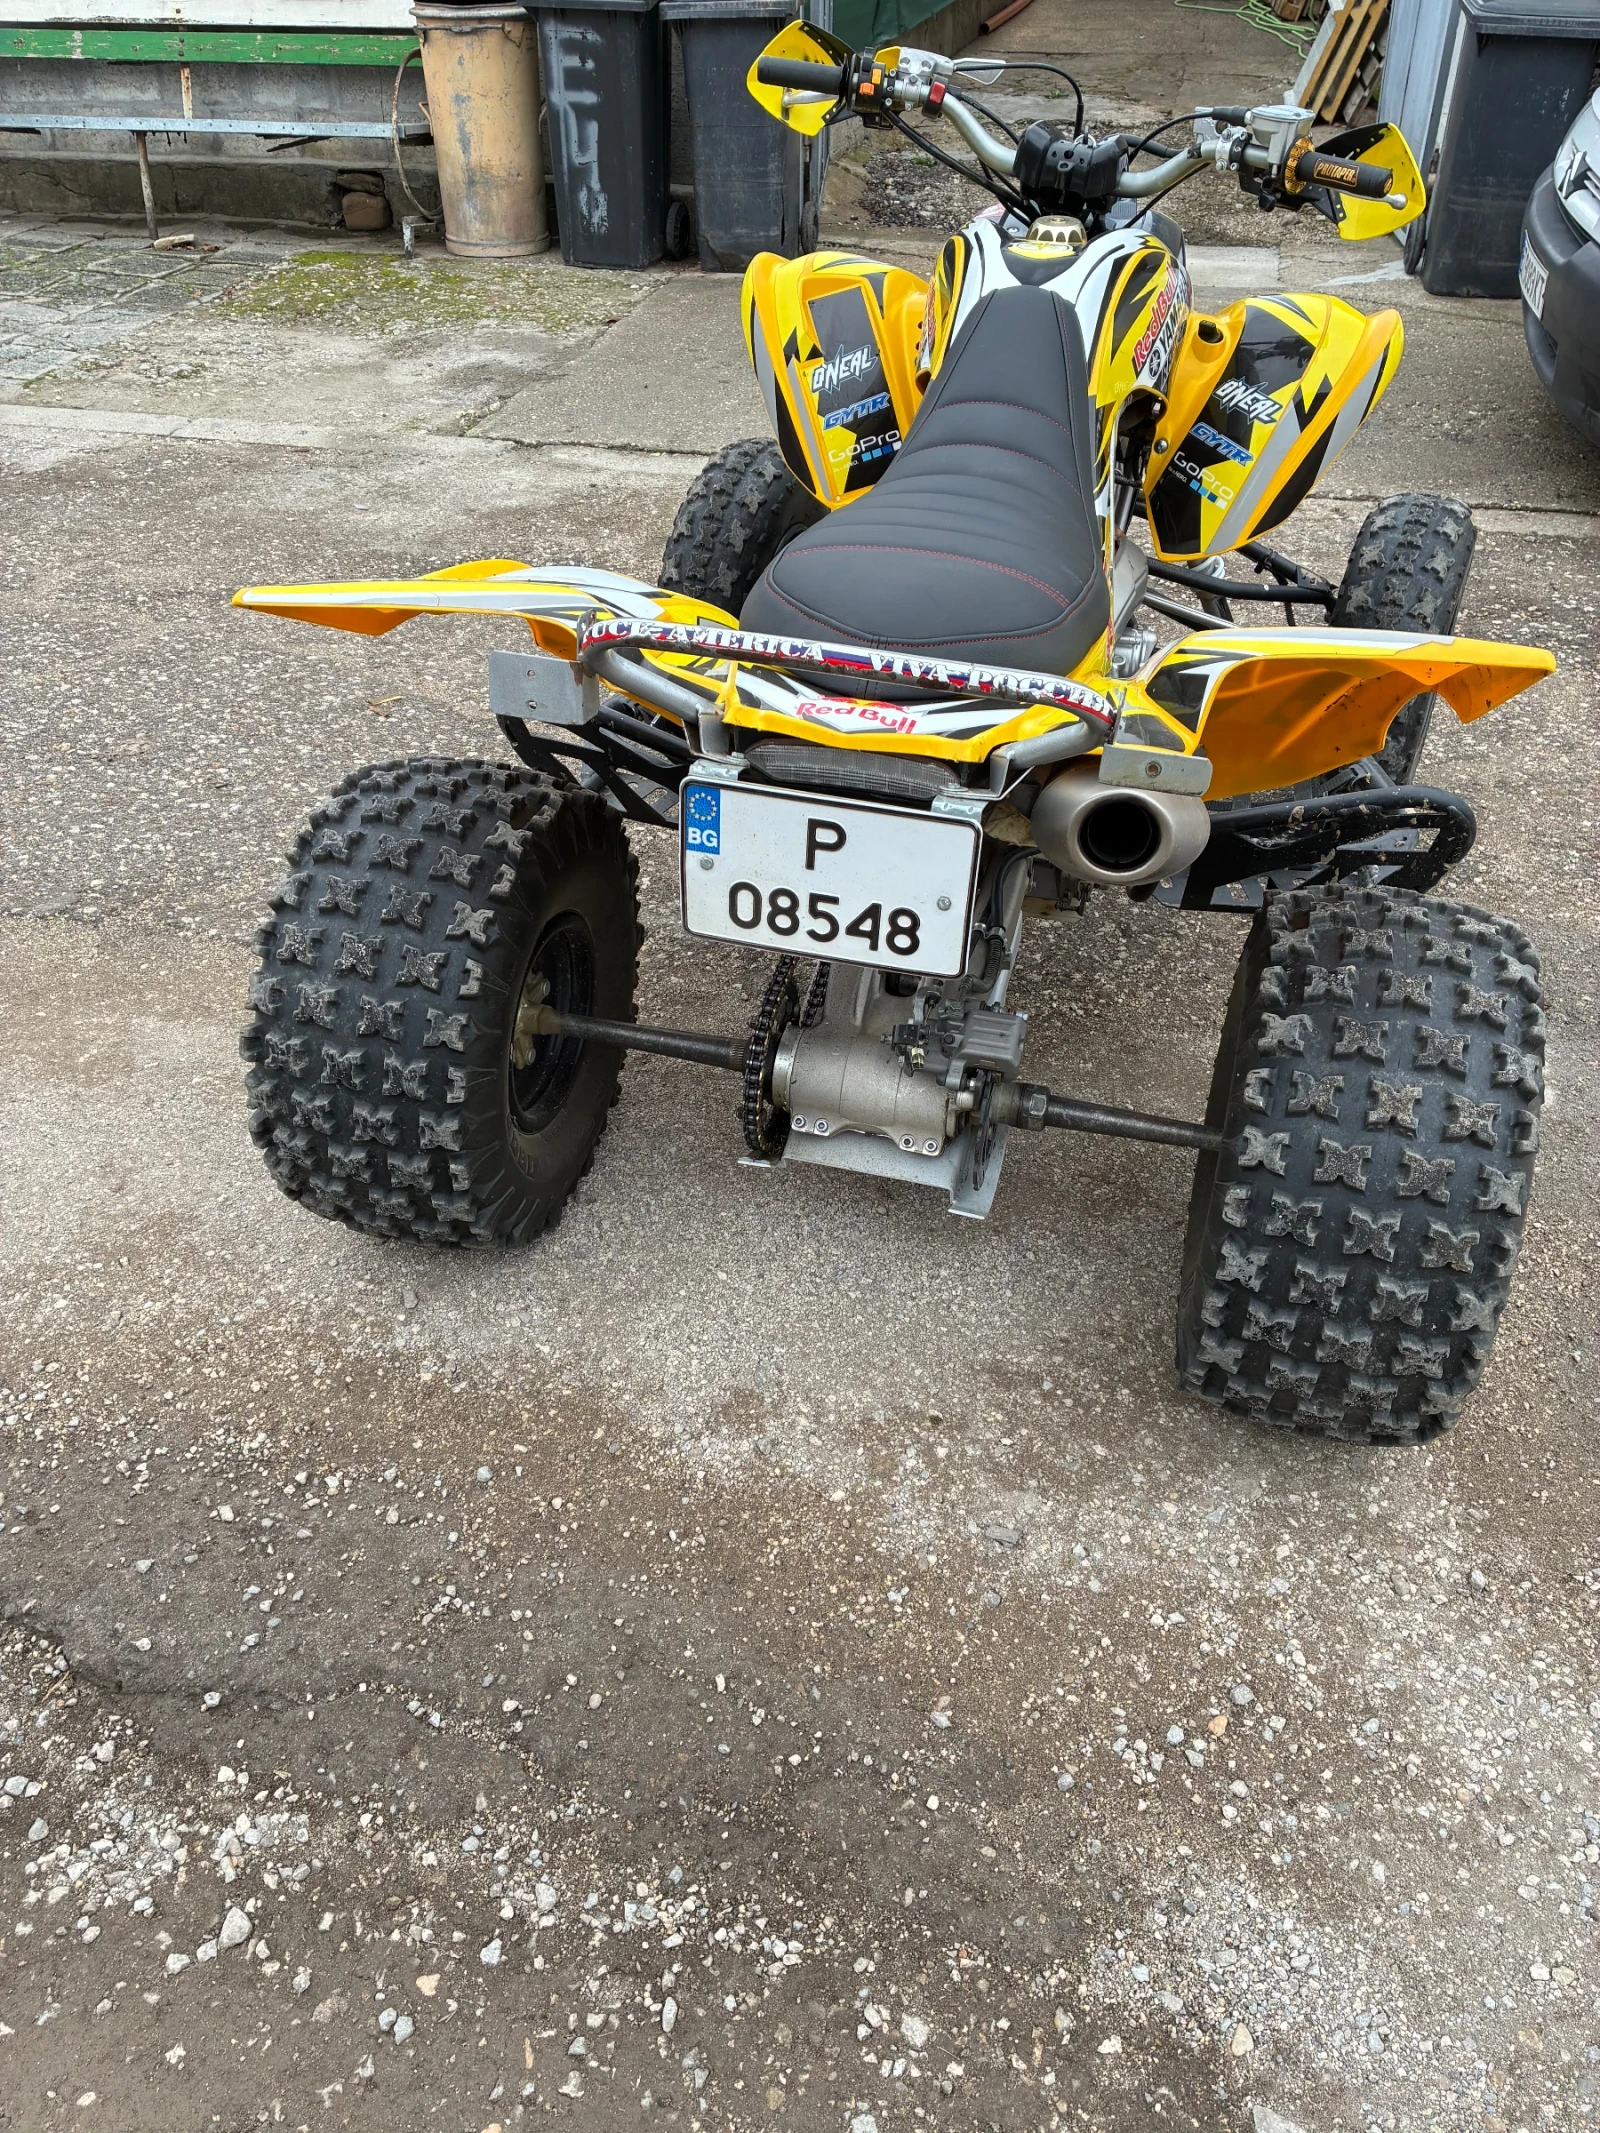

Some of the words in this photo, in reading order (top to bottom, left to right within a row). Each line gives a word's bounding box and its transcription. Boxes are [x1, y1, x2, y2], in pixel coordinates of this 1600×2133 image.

[1133, 304, 1161, 371] Red
[1156, 261, 1178, 321] Bull
[823, 391, 890, 430] GYTR
[828, 429, 900, 463] GoPro
[1189, 422, 1253, 467] GYTR
[1173, 451, 1234, 500] GoPro
[867, 652, 950, 684] VIVA
[796, 702, 857, 716] Red
[858, 708, 917, 734] Bull
[687, 827, 719, 848] BG
[804, 816, 847, 870] P
[728, 880, 921, 956] 08548
